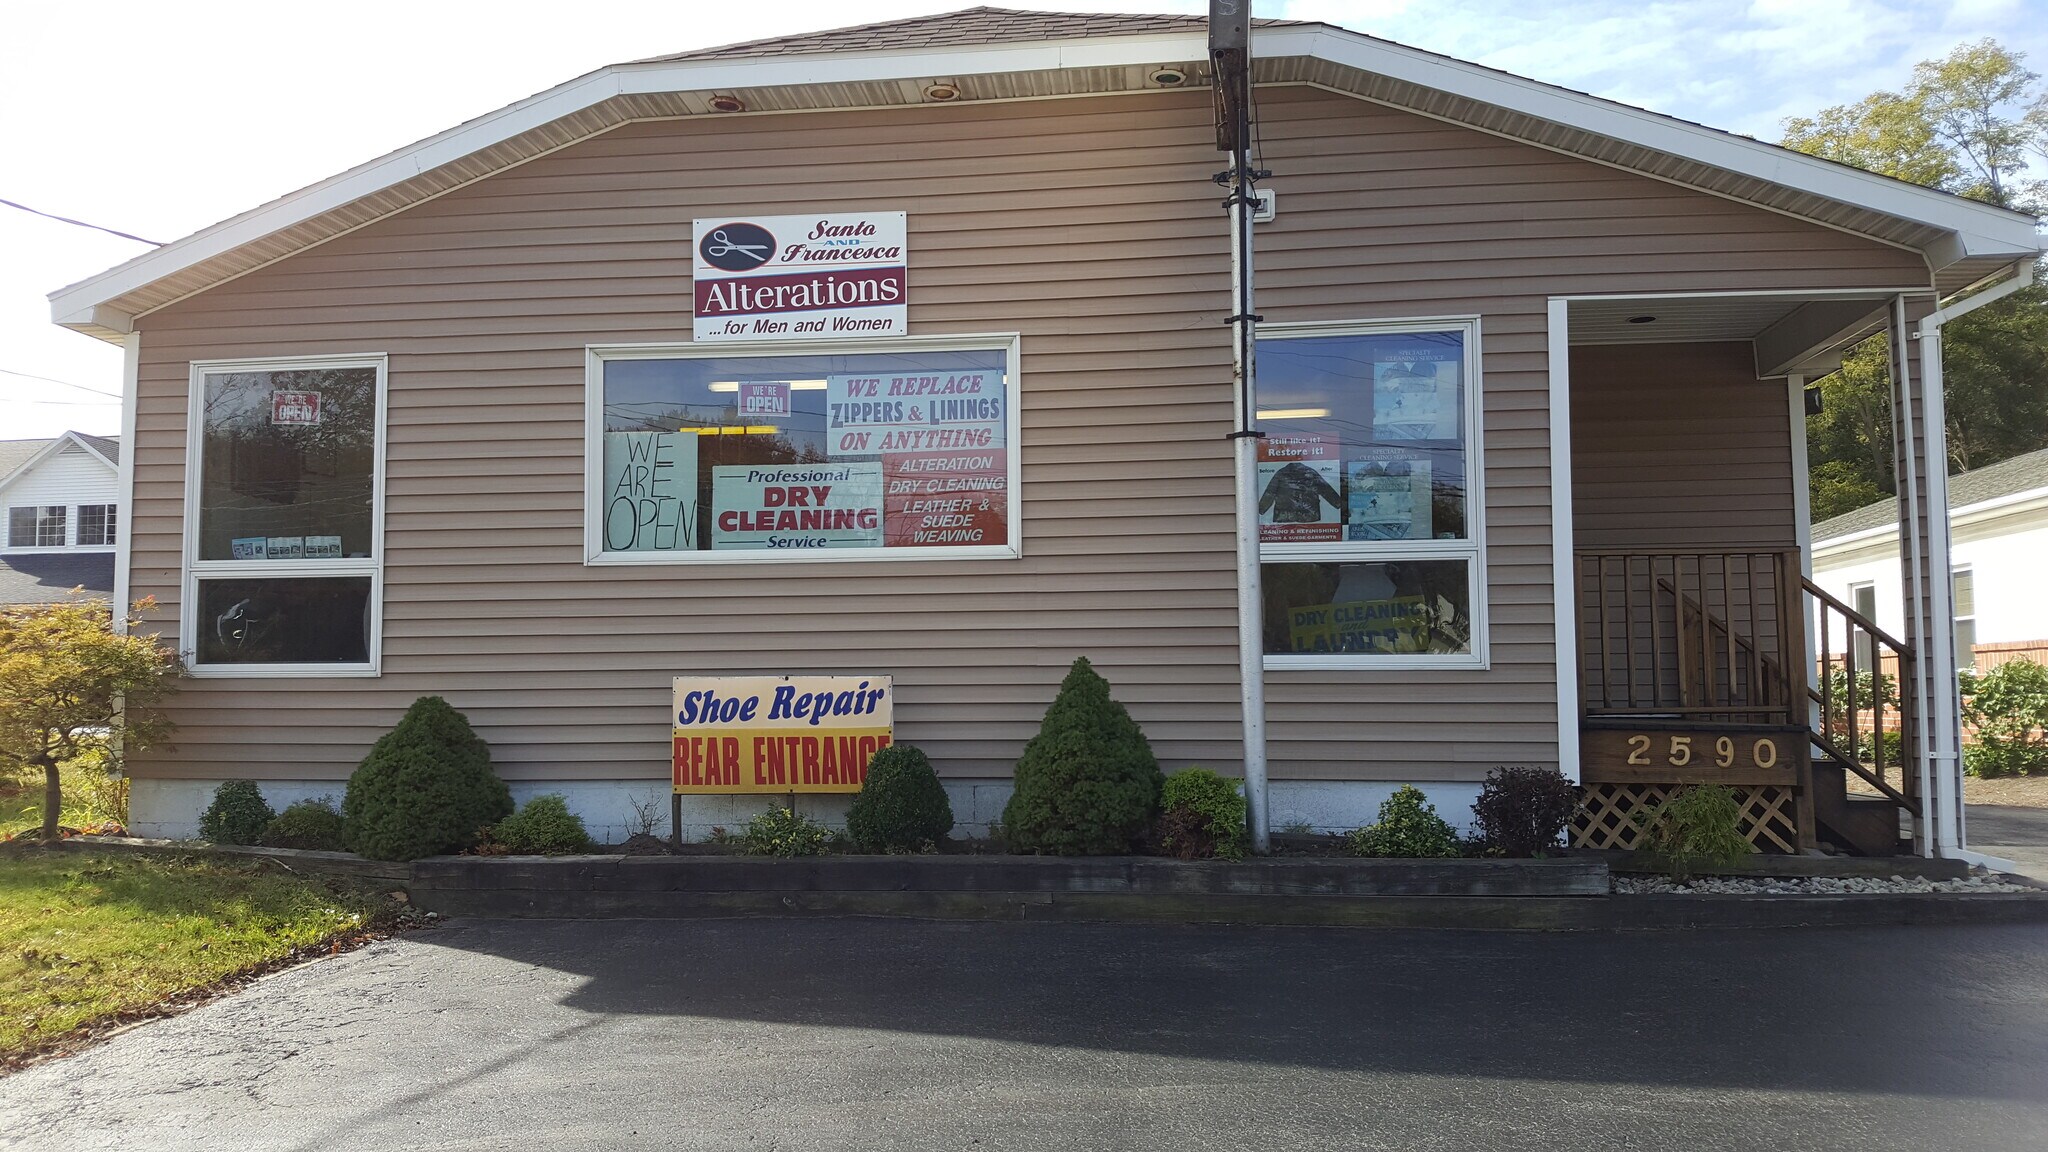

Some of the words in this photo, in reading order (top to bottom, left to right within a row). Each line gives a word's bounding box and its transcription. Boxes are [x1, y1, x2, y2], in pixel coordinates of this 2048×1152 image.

[808, 219, 877, 240] Santo
[781, 244, 900, 262] Francesca
[702, 276, 899, 313] Alterations
[753, 319, 788, 334] Men
[794, 318, 826, 333] and
[832, 317, 893, 331] Women
[752, 386, 777, 396] WE'RE
[847, 378, 879, 397] WE
[888, 375, 983, 396] REPLACE
[279, 404, 312, 421] OPEN
[746, 396, 783, 413] OPEN
[831, 400, 903, 428] ZIPPERS
[907, 406, 924, 421] &
[929, 398, 1000, 426] LININGS
[839, 432, 870, 451] ON
[879, 429, 992, 450] ANYTHING
[626, 432, 674, 467] WE
[1268, 448, 1308, 456] Restore
[899, 457, 993, 473] ALTERATION
[614, 463, 672, 498] ARE
[747, 467, 850, 483] Professional
[888, 480, 923, 494] DRY
[926, 477, 1005, 492] CLEANING
[763, 486, 833, 508] DRY
[903, 499, 973, 514] LEATHER
[979, 498, 990, 511] &
[607, 496, 698, 551] OPEN
[718, 510, 877, 531] CLEANING
[920, 514, 975, 528] SUEDE
[766, 535, 827, 549] Service
[913, 529, 983, 543] WEAVING
[1294, 610, 1328, 626] DRY
[1334, 601, 1420, 623] CLEANING
[1341, 619, 1369, 631] and
[679, 690, 759, 725] Shoe
[768, 681, 884, 726] Repair
[674, 736, 741, 786] REAR
